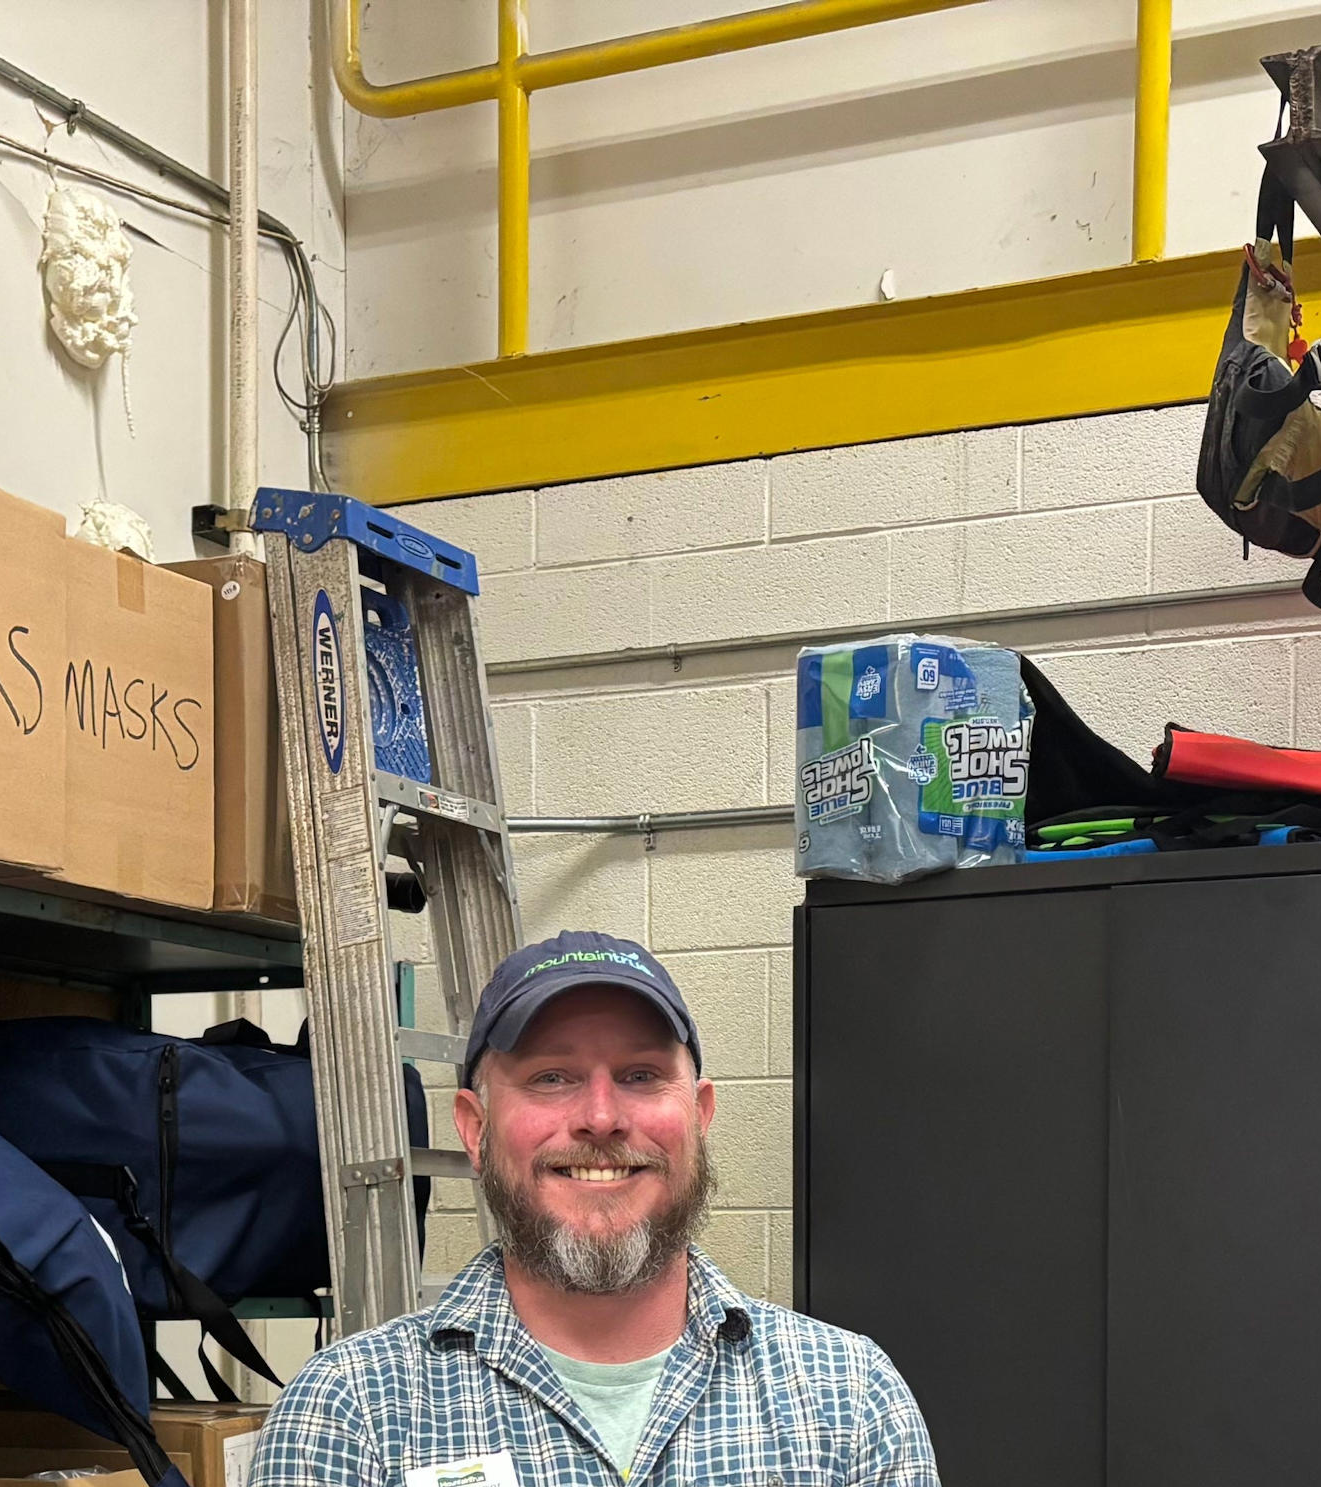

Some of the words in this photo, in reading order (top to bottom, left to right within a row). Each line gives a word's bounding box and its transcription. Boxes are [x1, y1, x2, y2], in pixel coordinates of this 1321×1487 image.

[317, 626, 340, 740] WERNER
[64, 657, 203, 771] MASKS
[945, 718, 1032, 754] TOWELS
[801, 738, 873, 786] TOWELS
[950, 751, 1030, 796] SHOP
[805, 770, 872, 805] SHOP
[809, 795, 850, 819] BLUE
[952, 780, 1003, 799] BLUE
